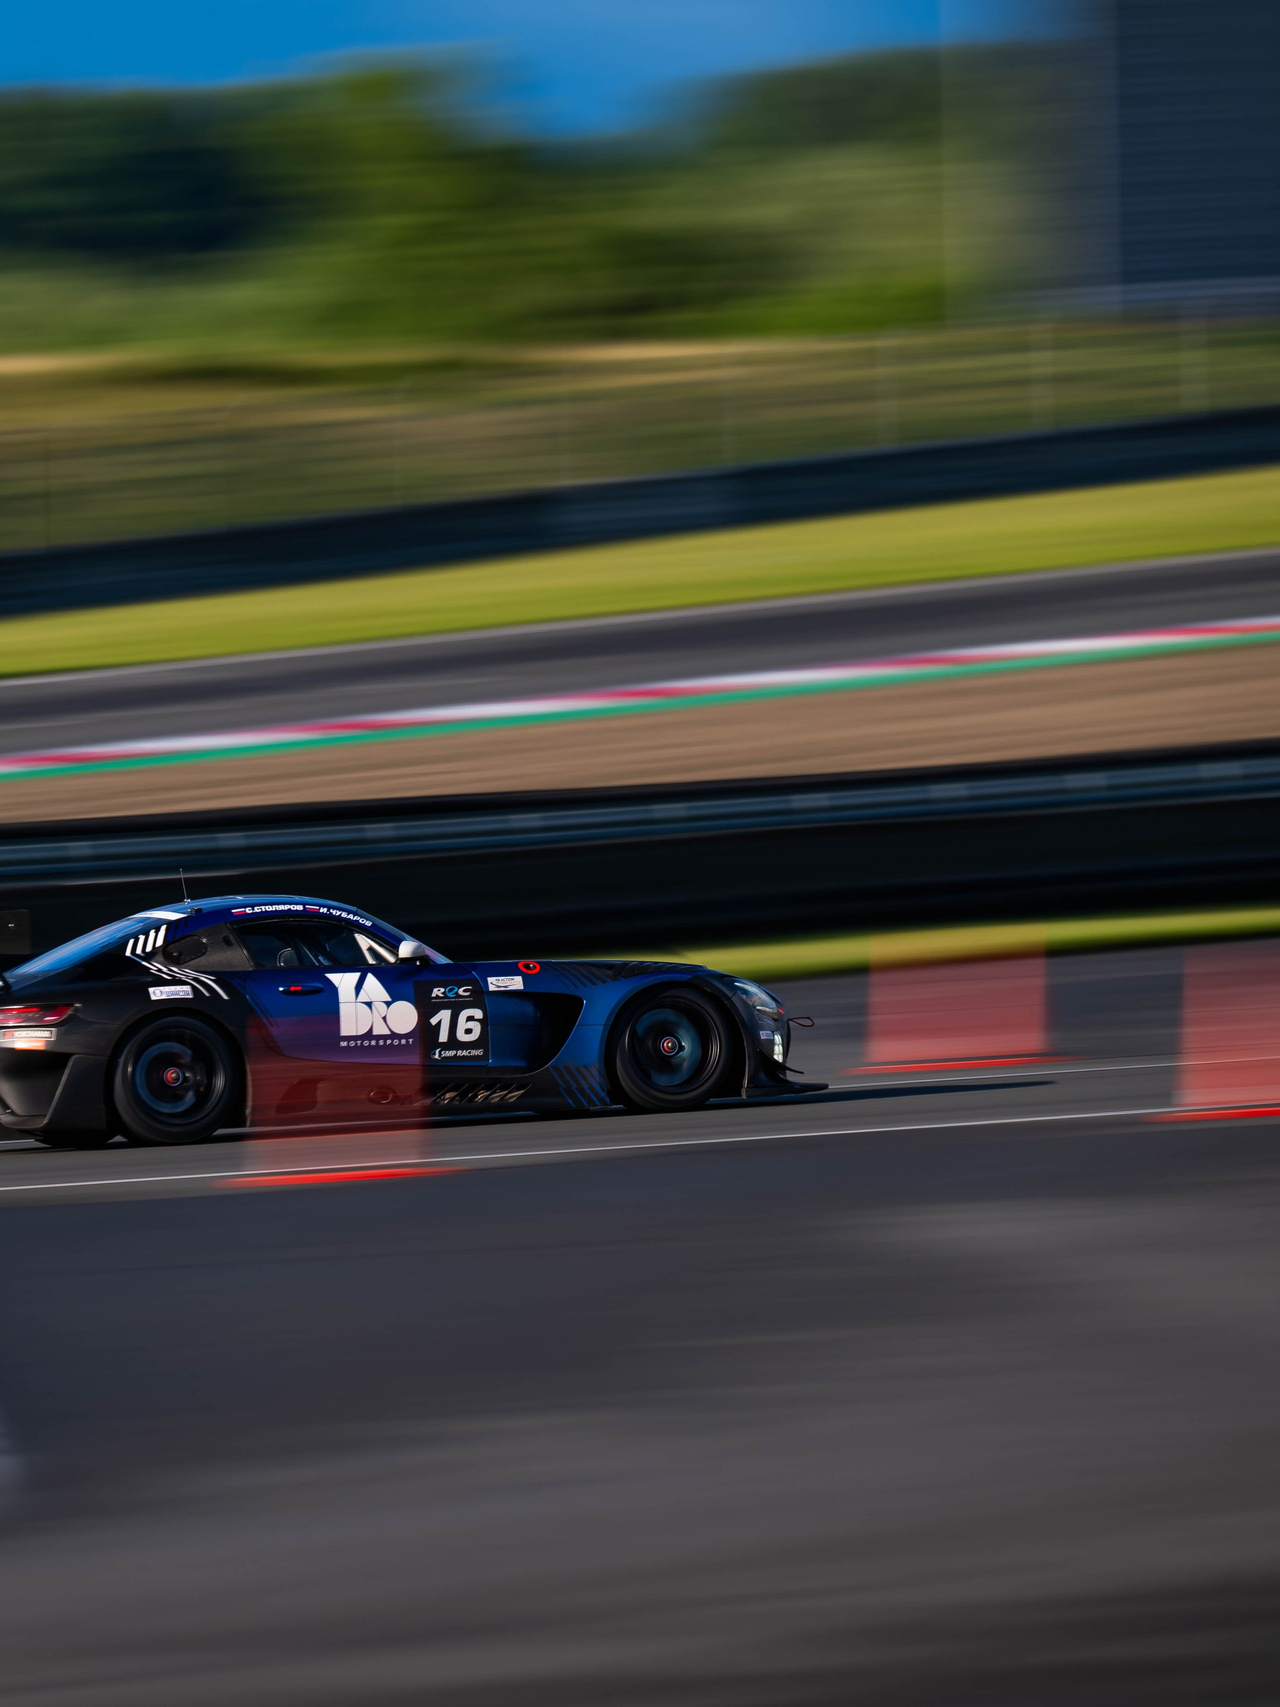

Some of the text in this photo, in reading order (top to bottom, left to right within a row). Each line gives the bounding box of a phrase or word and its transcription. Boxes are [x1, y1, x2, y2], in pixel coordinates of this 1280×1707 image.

[429, 1008, 484, 1043] 16
[340, 1038, 414, 1047] MOTORSPORT
[440, 1049, 484, 1058] SMP RACING
